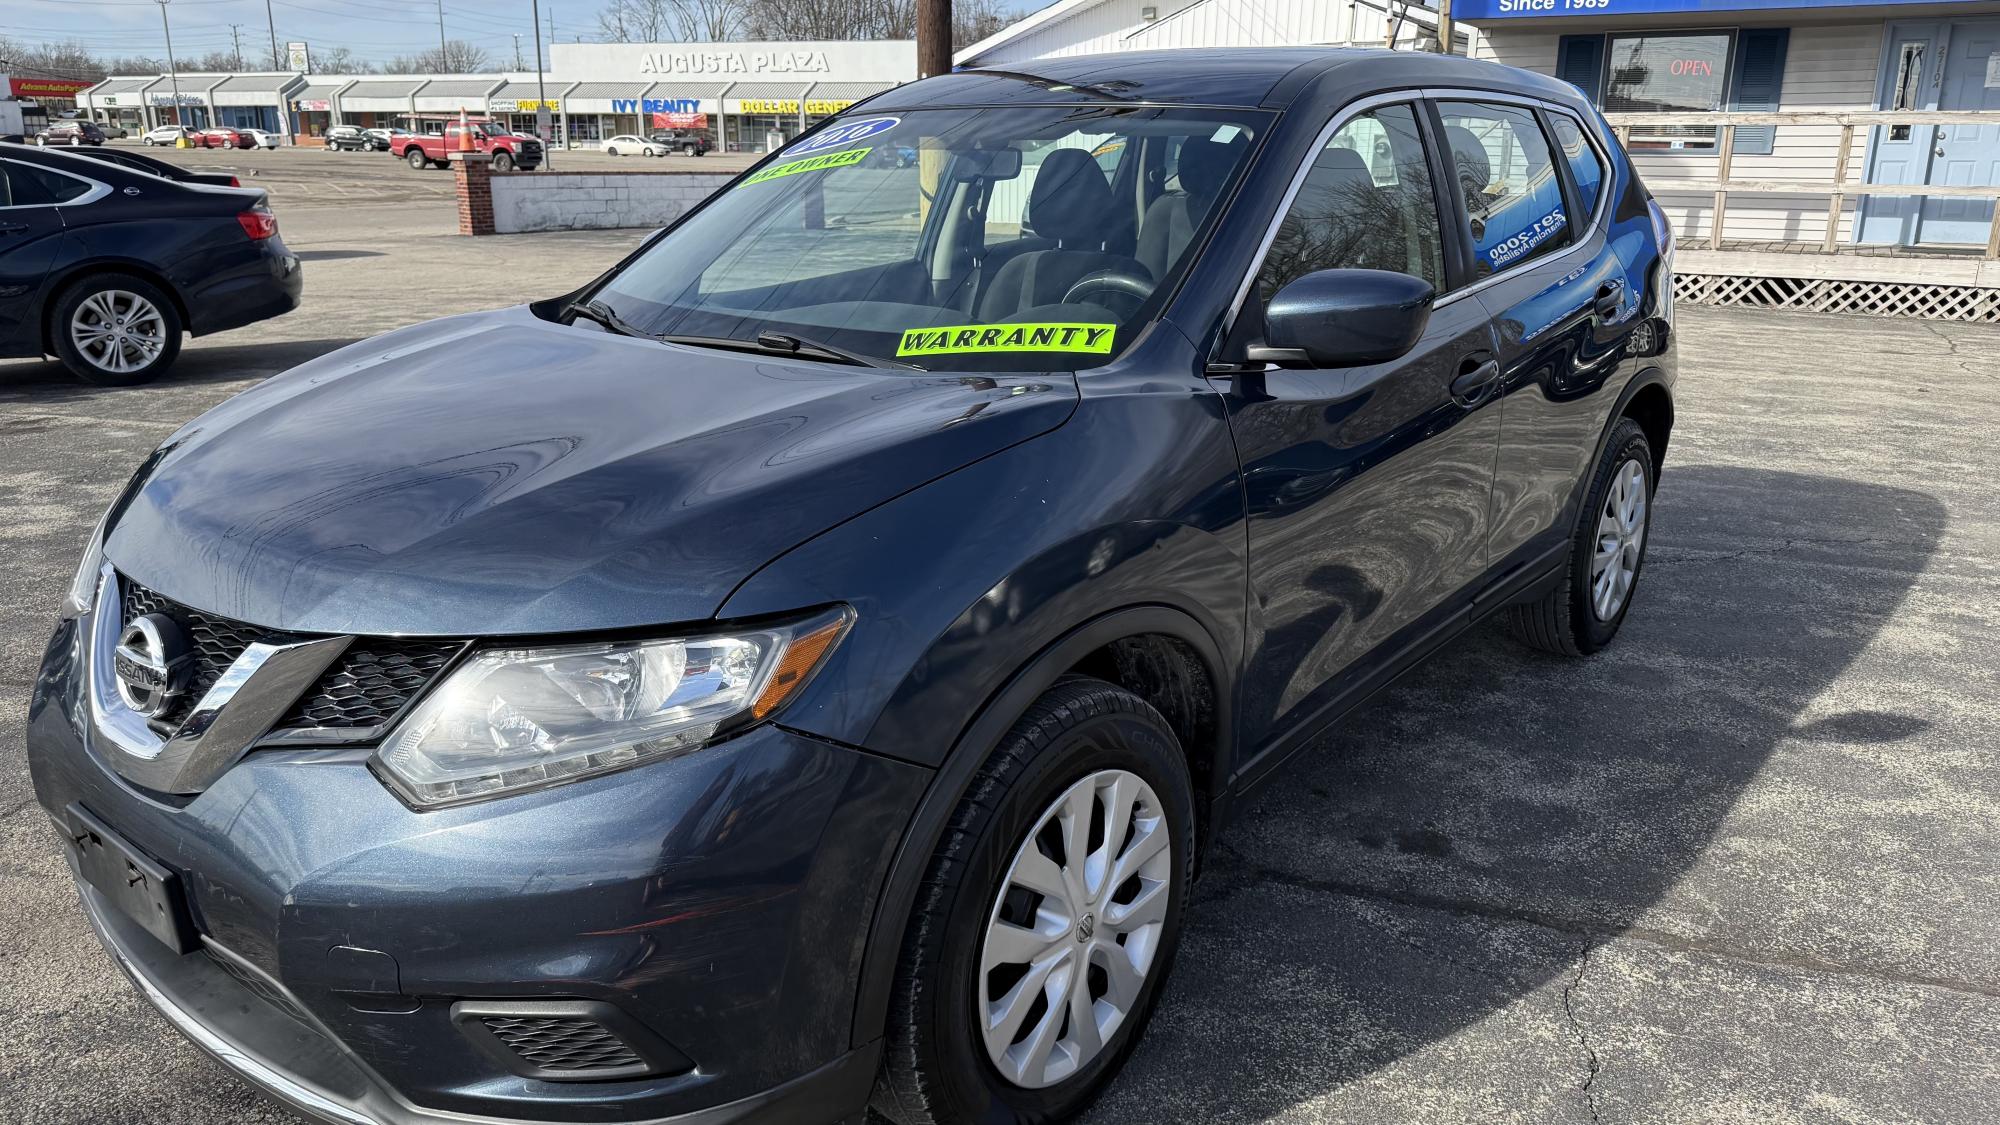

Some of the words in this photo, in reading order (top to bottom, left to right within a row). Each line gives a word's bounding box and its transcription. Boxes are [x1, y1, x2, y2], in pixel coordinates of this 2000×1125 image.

[1499, 0, 1554, 11] Since
[1564, 0, 1610, 9] 1989
[640, 52, 747, 73] AUGUSTA
[754, 51, 830, 73] PLAZA
[1670, 59, 1713, 76] OPEN
[612, 99, 639, 113] IVY
[643, 98, 701, 113] BEAUTY
[740, 99, 799, 114] DOLLAR
[790, 119, 887, 154] 2016
[786, 150, 866, 173] OWNER
[903, 327, 1110, 351] WARRANTY
